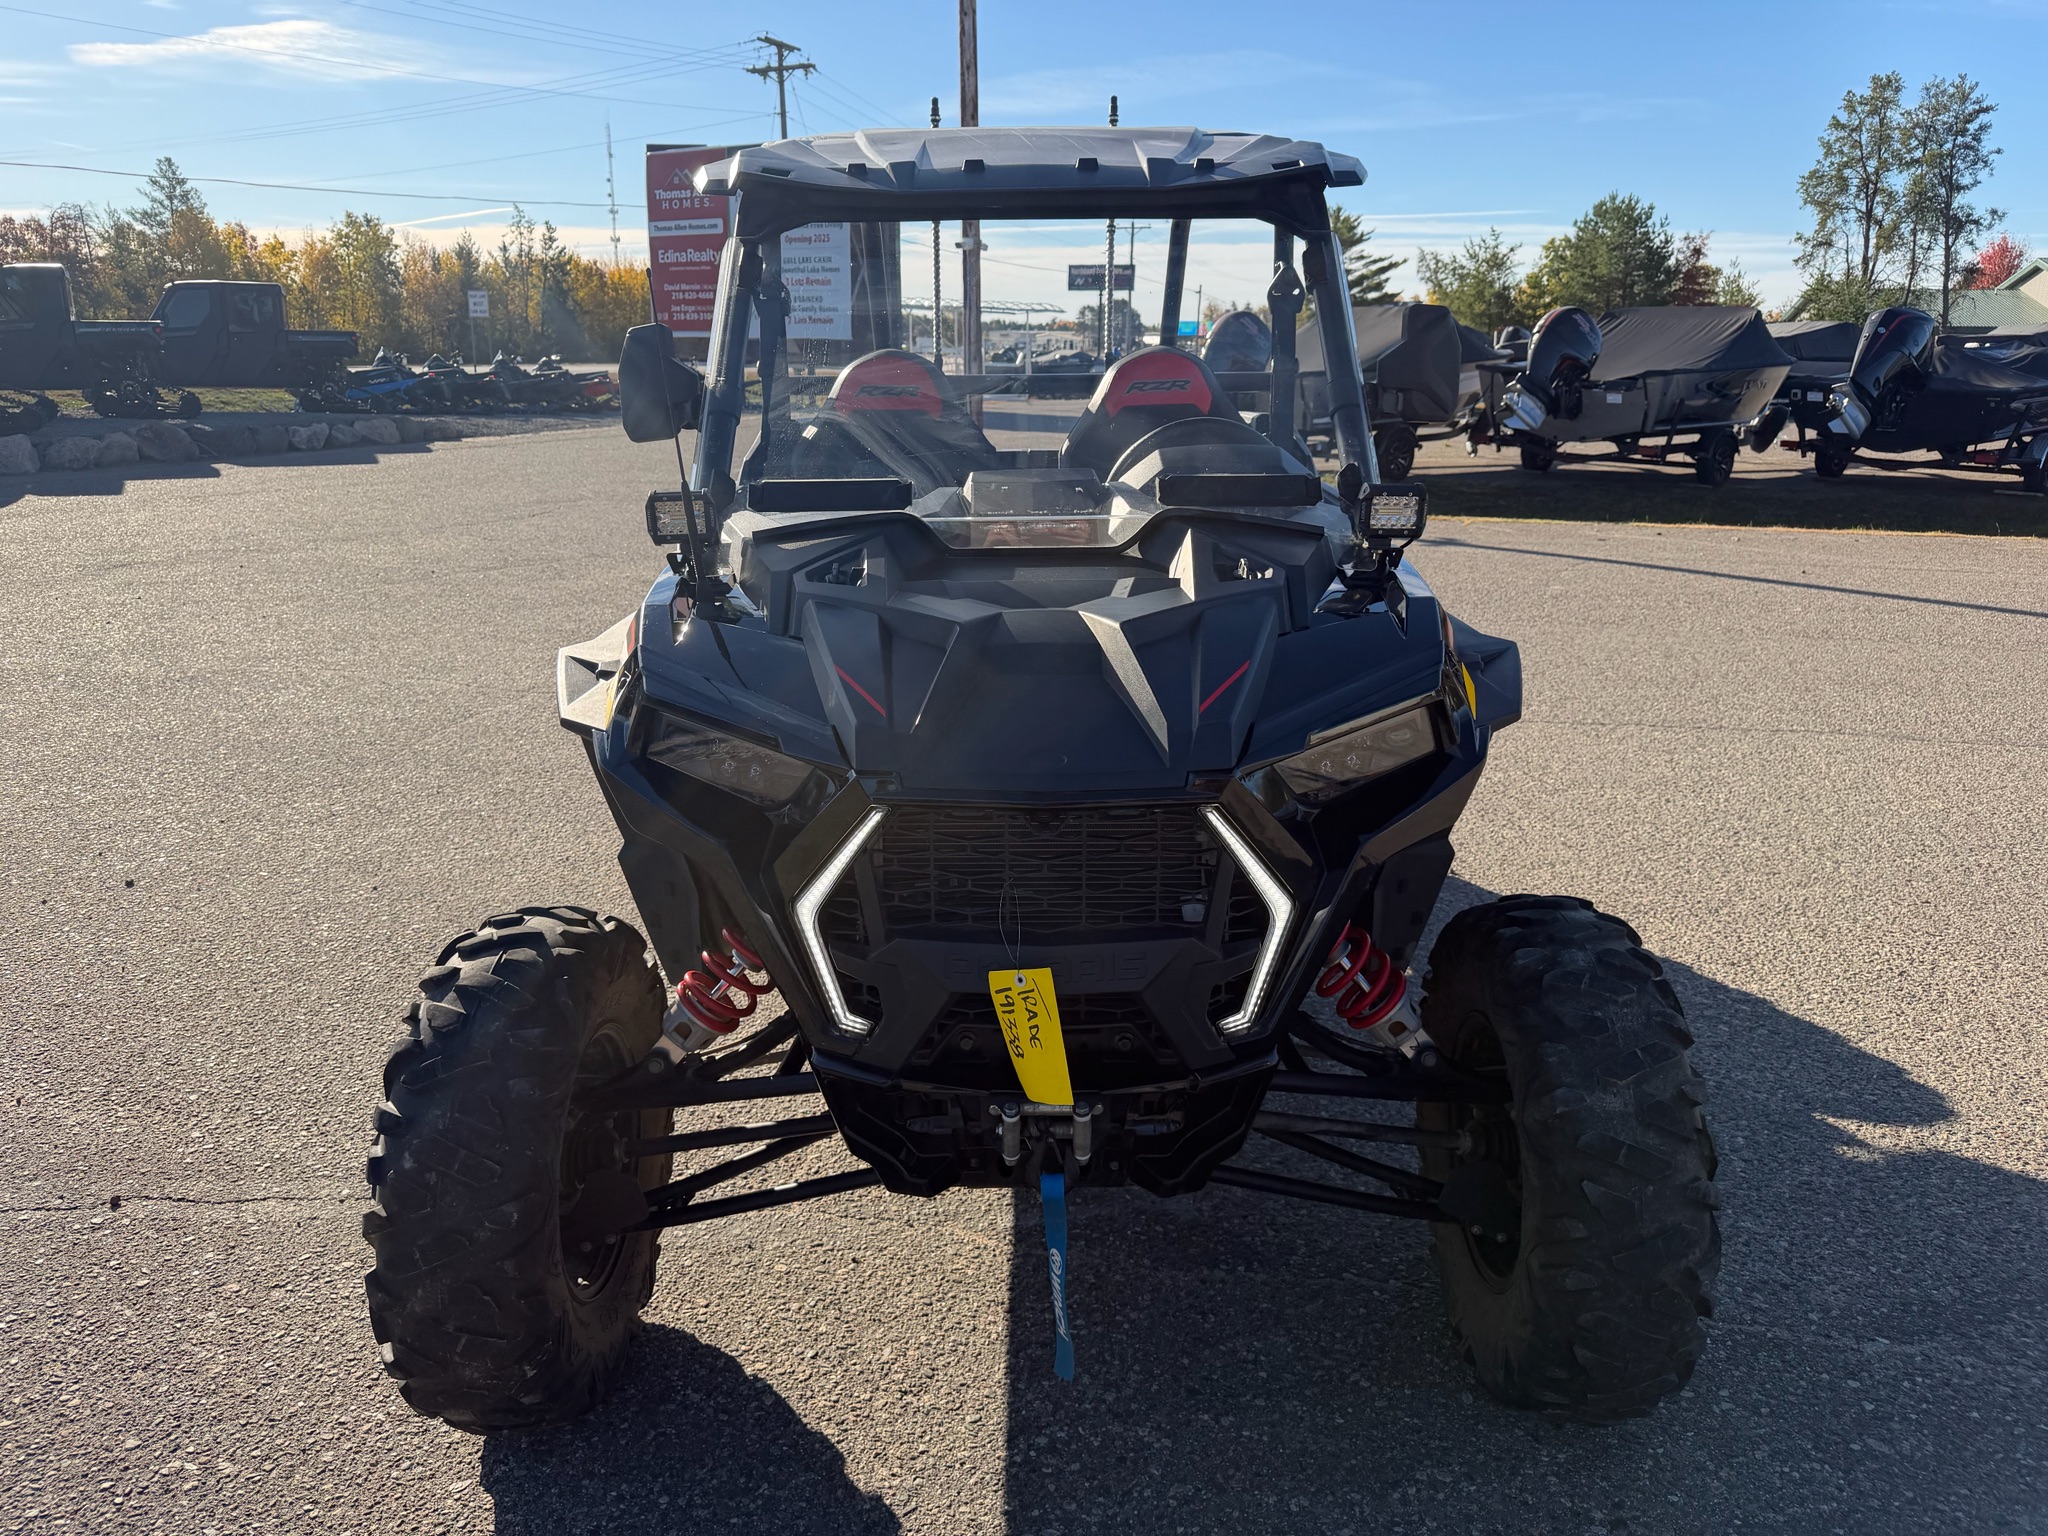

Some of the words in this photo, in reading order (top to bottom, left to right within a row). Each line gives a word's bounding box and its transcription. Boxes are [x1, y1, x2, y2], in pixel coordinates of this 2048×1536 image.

[654, 189, 691, 200] Thomas
[662, 197, 710, 209] HOMES
[784, 235, 812, 245] Opening
[813, 233, 831, 243] 2025
[855, 384, 923, 398] RZR
[1125, 379, 1192, 396] RZR
[1017, 977, 1053, 1051] TRADE
[1050, 1271, 1069, 1342] WINCH
